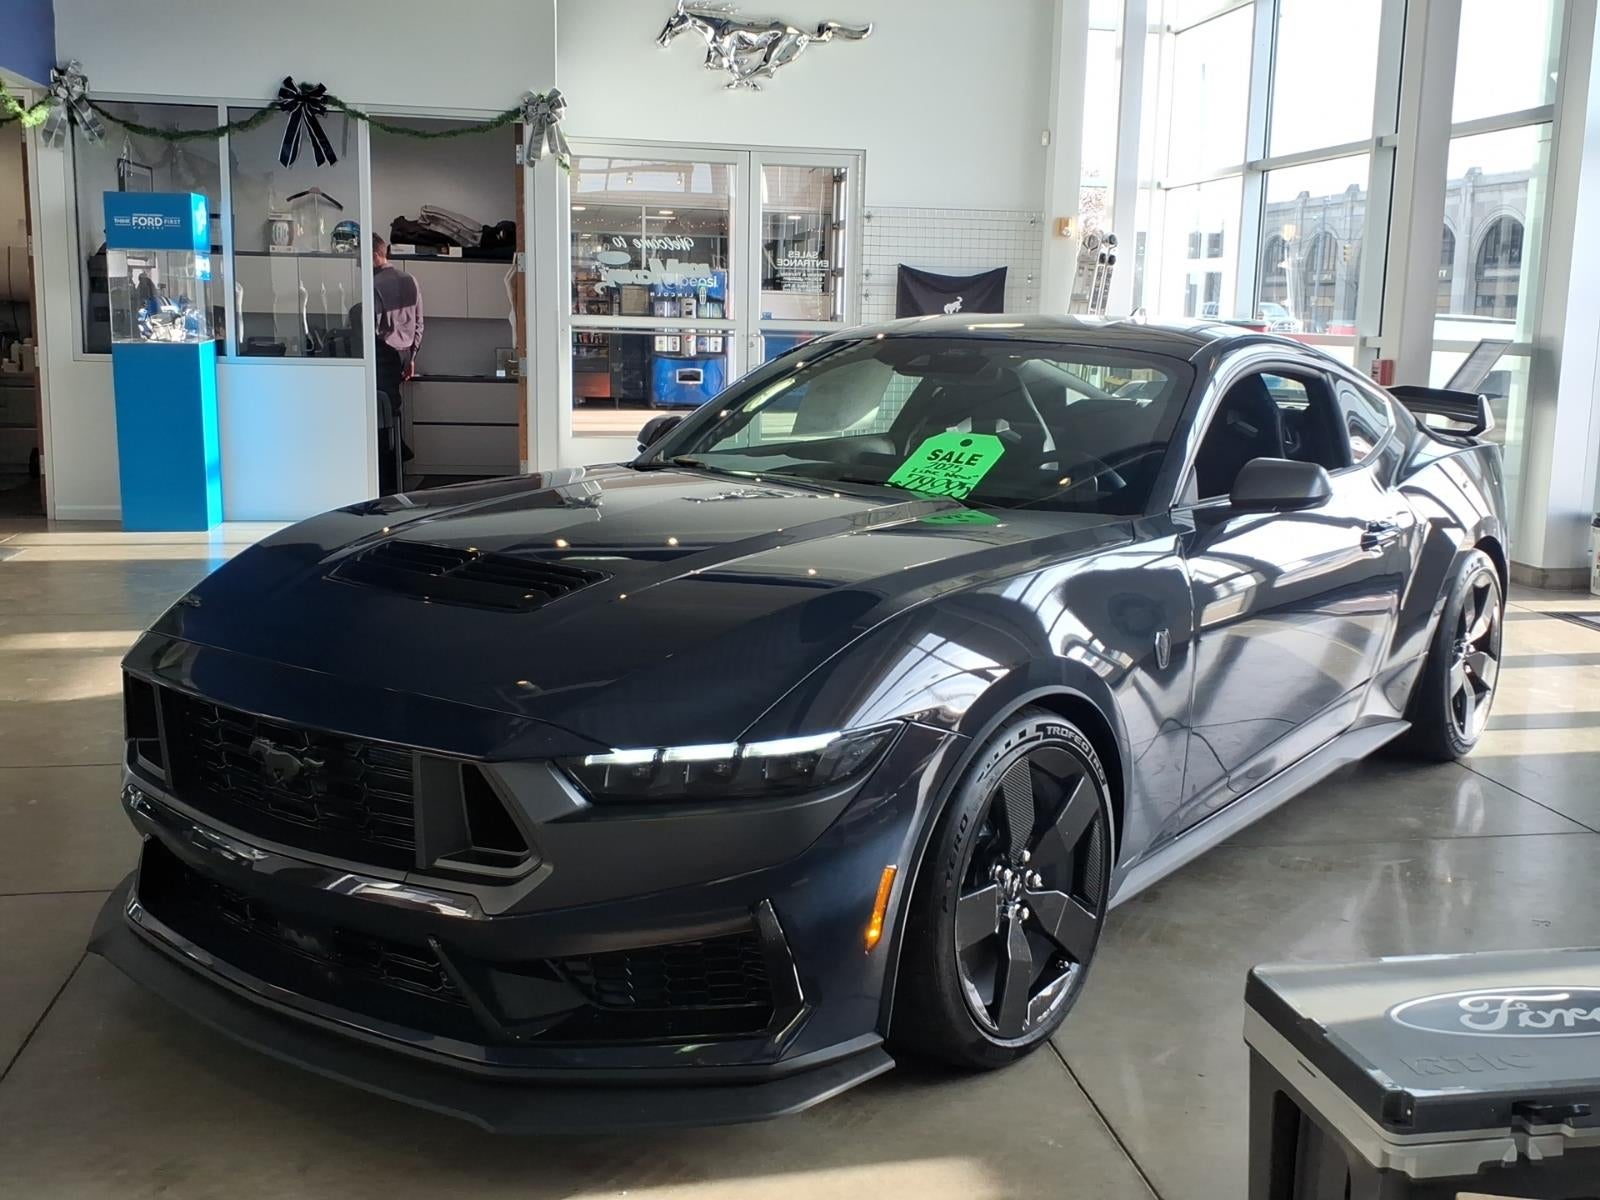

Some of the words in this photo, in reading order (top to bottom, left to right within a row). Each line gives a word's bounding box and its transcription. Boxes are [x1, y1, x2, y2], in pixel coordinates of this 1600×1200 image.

[132, 216, 163, 226] FORD
[678, 275, 718, 289] pepsi
[926, 448, 984, 467] SALE
[1046, 725, 1090, 753] TROFEO
[1458, 992, 1600, 1031] For
